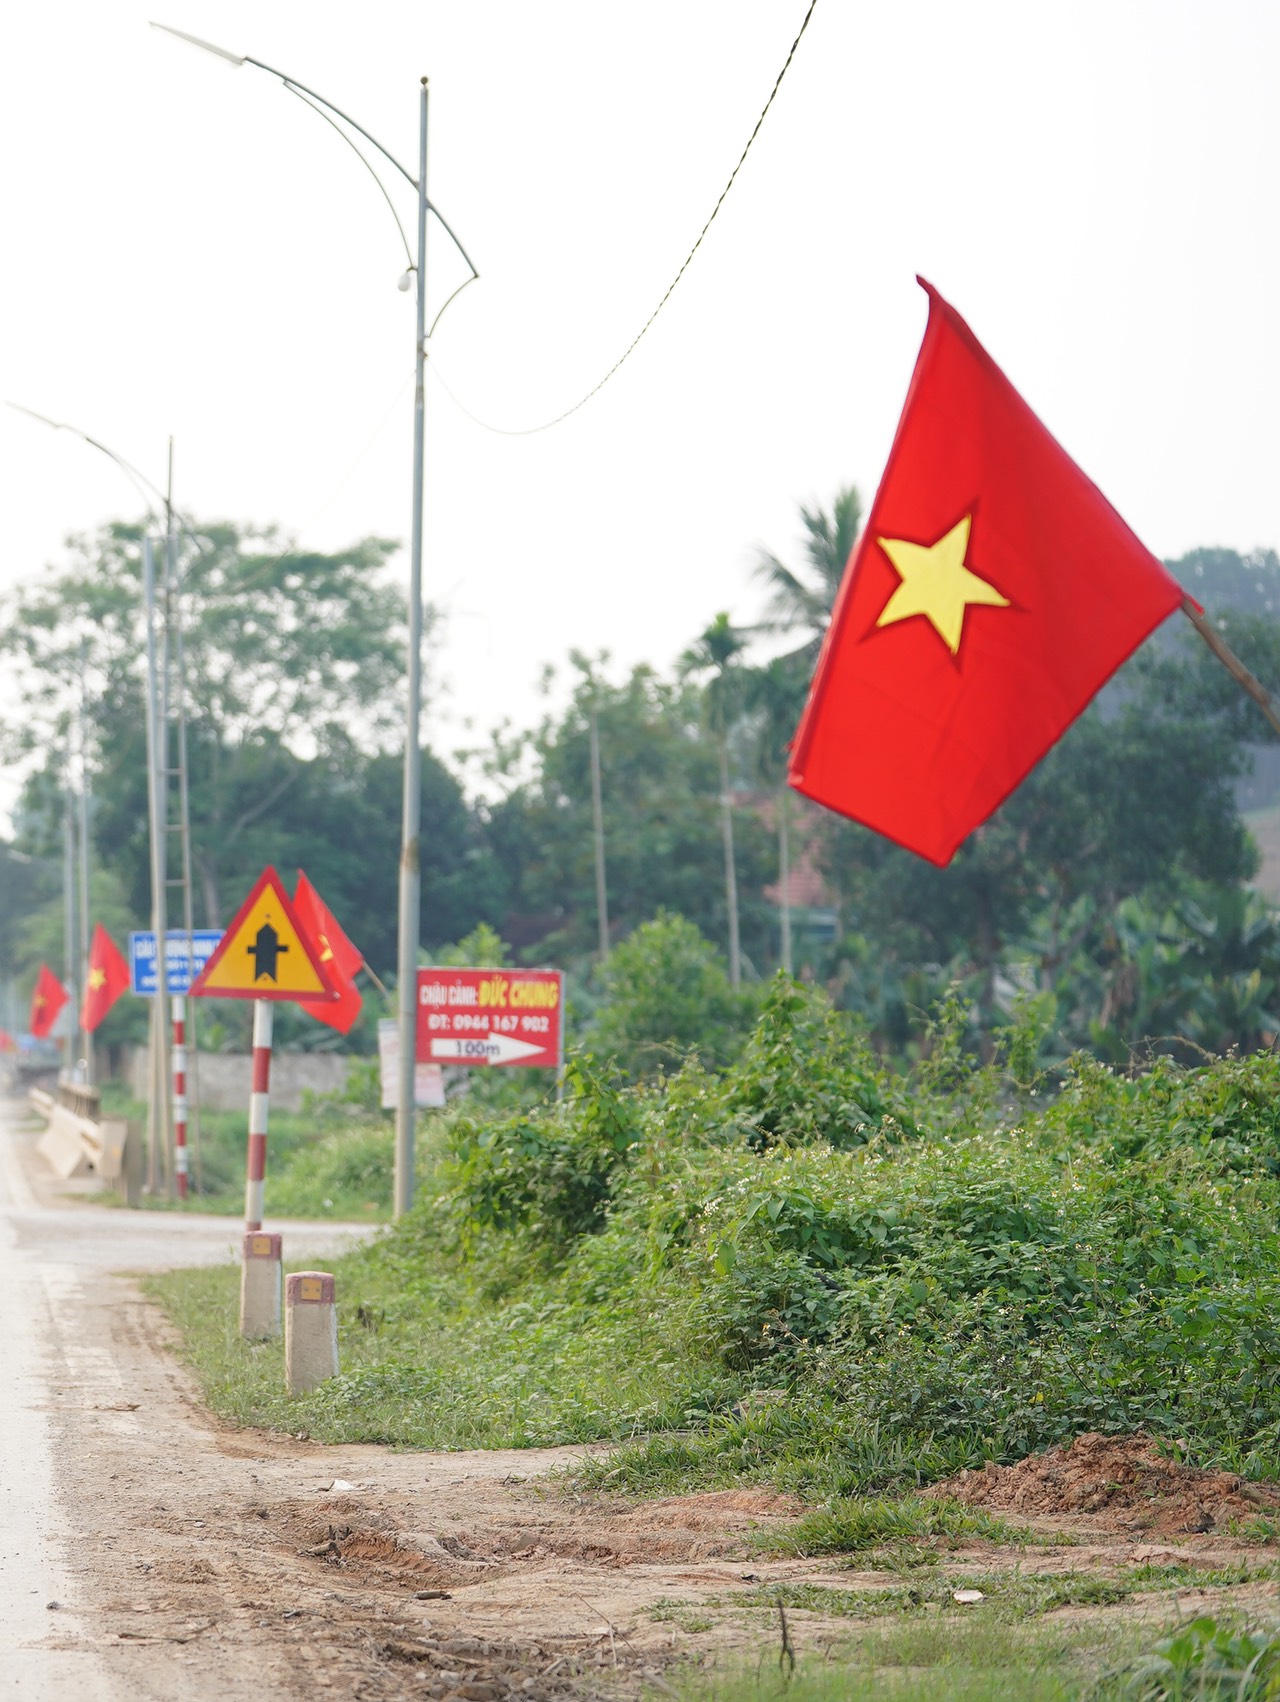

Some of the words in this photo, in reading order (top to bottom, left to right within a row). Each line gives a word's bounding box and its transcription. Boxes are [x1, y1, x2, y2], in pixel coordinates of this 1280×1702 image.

[479, 974, 508, 1008] ĐỨC
[509, 980, 559, 1009] CHUNG
[428, 1014, 451, 1030] ĐT:
[493, 1015, 519, 1031] 167
[456, 1040, 500, 1056] 100m
